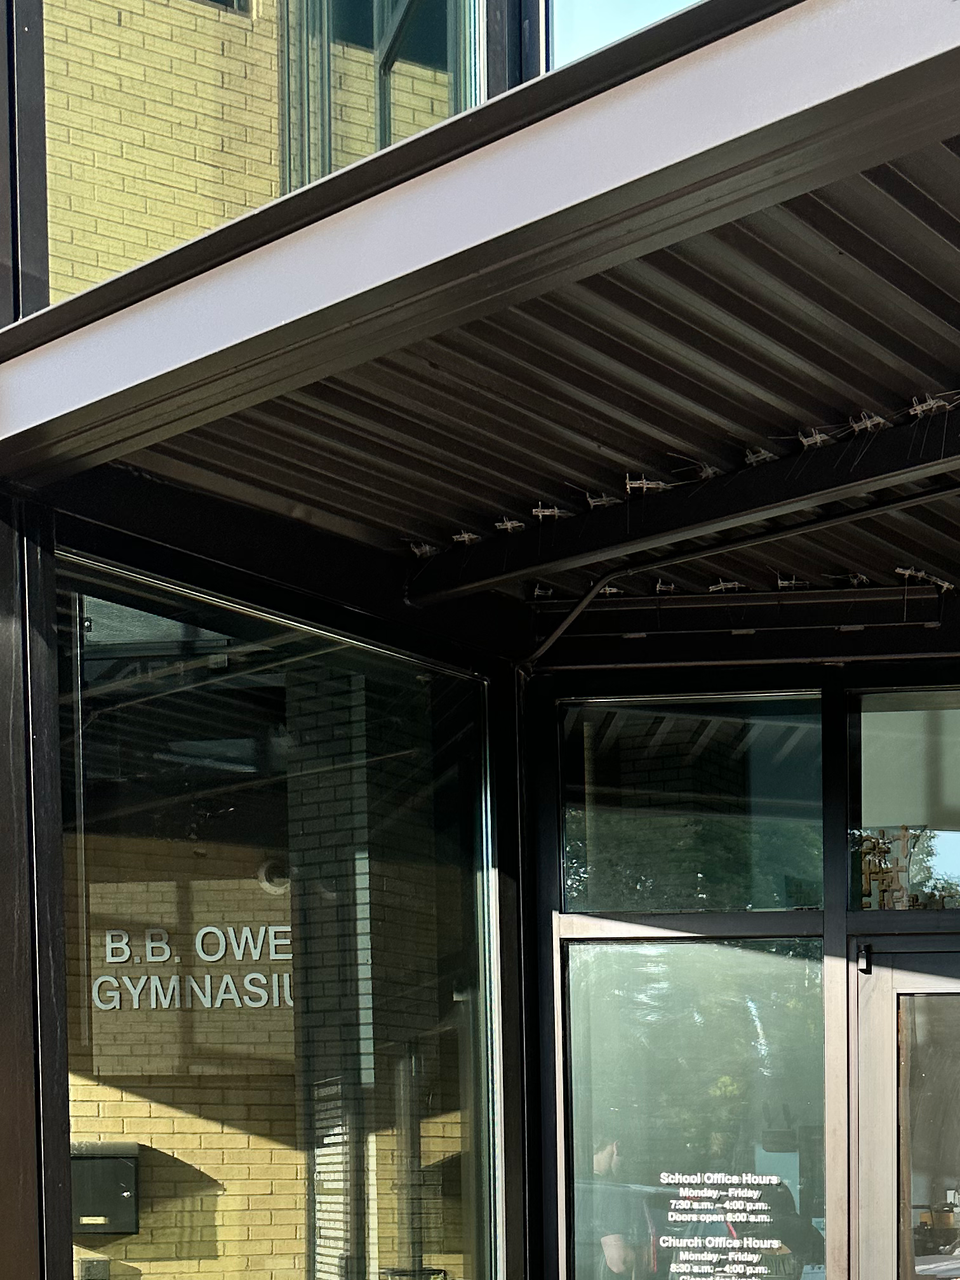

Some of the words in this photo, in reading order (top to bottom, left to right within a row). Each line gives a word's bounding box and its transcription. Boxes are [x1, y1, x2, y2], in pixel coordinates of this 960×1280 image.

[660, 1173, 700, 1184] School
[704, 1173, 738, 1184] Office
[742, 1173, 778, 1184] Hours
[680, 1188, 718, 1198] Monday
[728, 1188, 759, 1199] Friday
[670, 1200, 690, 1209] 7:30
[724, 1200, 744, 1210] 4:00
[668, 1212, 697, 1221] Doors
[700, 1214, 724, 1223] open
[660, 1237, 702, 1247] Church
[706, 1237, 740, 1247] Office
[744, 1237, 779, 1247] Hours
[680, 1252, 718, 1262] Monday
[729, 1252, 759, 1262] Friday
[724, 1264, 744, 1274] 4:00
